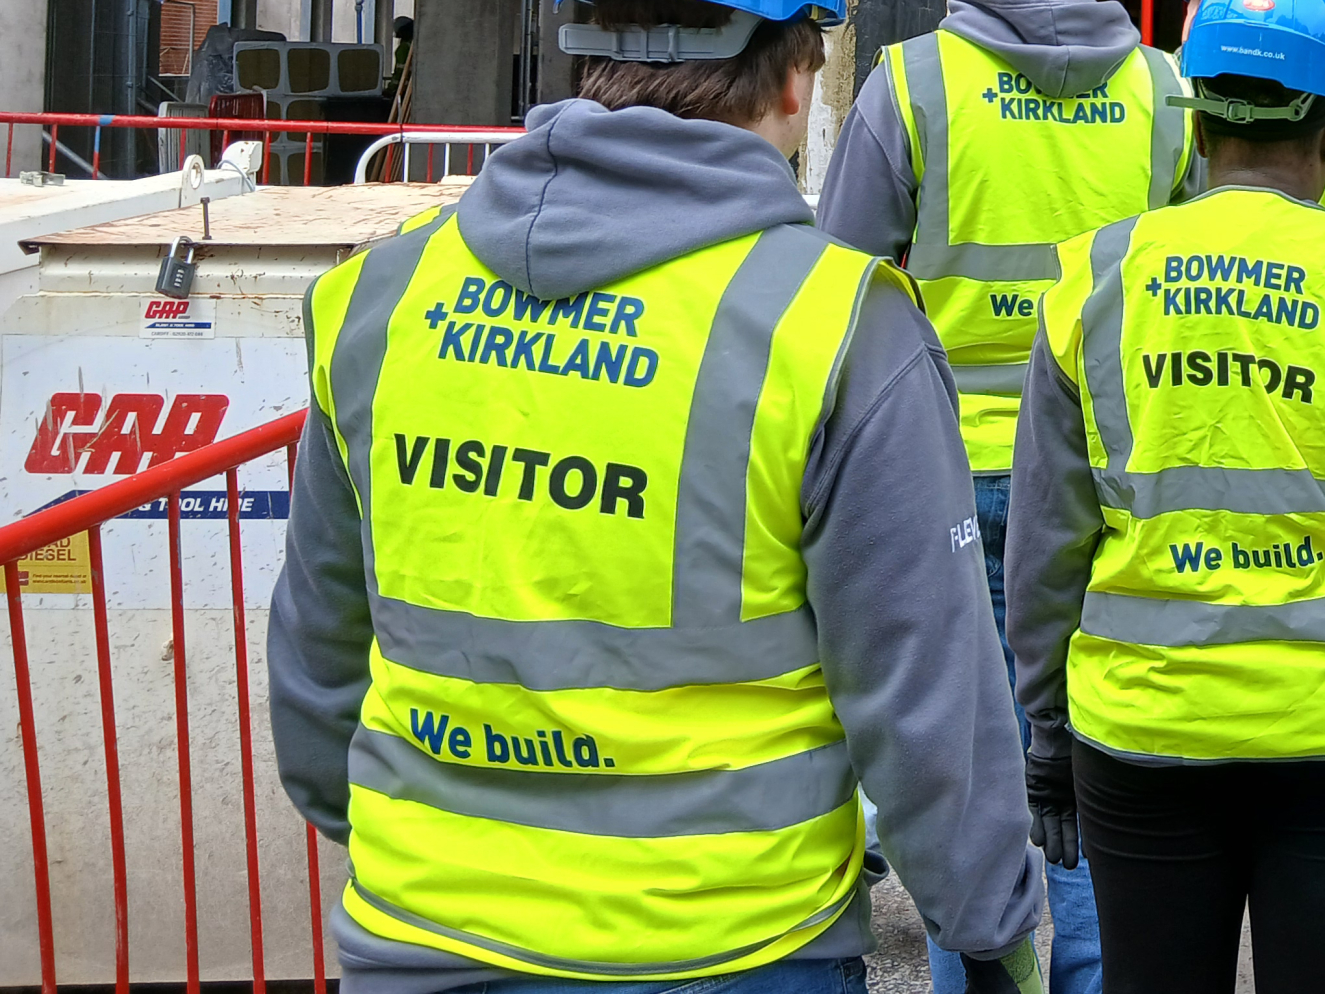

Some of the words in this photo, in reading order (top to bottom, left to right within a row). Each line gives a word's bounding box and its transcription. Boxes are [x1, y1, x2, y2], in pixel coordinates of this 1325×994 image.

[1221, 44, 1285, 60] www.bandk.co.uk
[1164, 254, 1306, 295] BOWMER
[453, 276, 645, 337] BOWMER
[990, 294, 1034, 317] We
[1142, 350, 1316, 404] VISITOR
[394, 433, 648, 519] VISITOR
[158, 497, 204, 512] TOL
[209, 497, 255, 512] HIE
[1169, 541, 1223, 573] We
[1231, 535, 1324, 569] build.
[410, 708, 473, 760] We
[483, 723, 616, 768] build.
